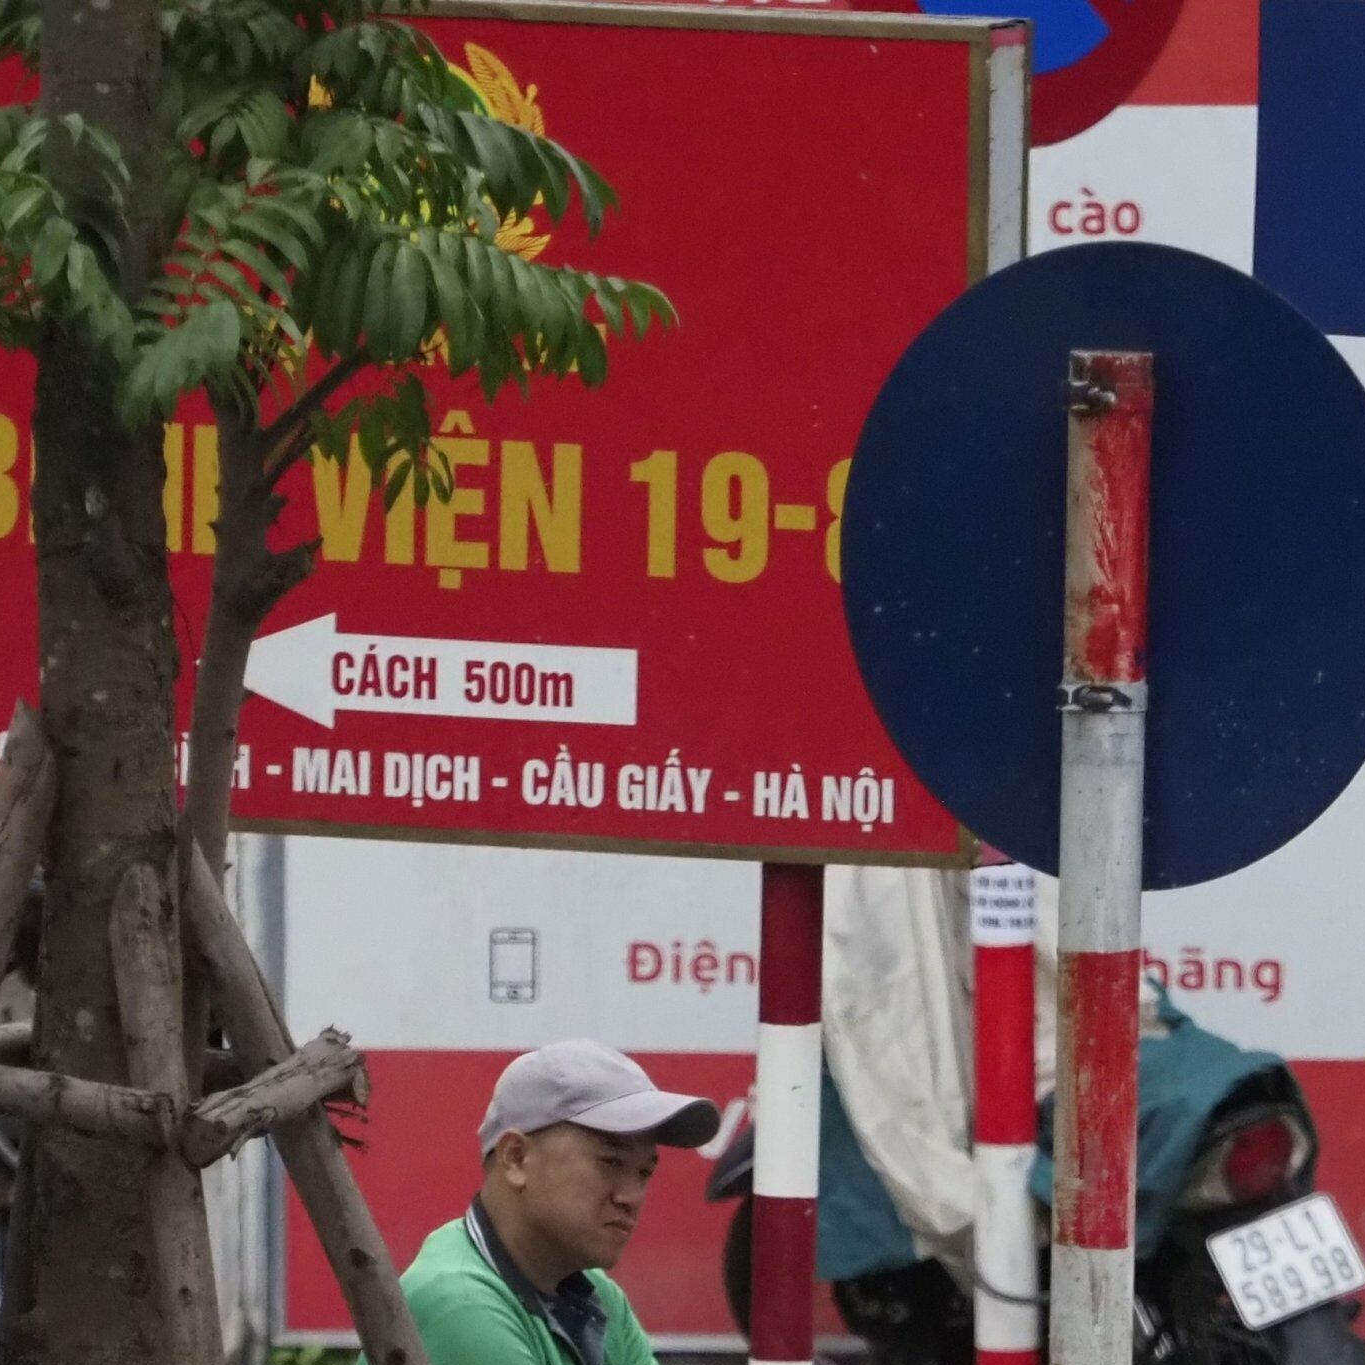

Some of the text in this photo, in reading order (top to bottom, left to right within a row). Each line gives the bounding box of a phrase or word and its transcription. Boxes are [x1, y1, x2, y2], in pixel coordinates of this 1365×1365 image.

[1048, 187, 1142, 236] cào
[311, 409, 582, 591] VIỆN
[331, 643, 574, 708] CÁCH 500m
[291, 747, 370, 796] MAI
[383, 752, 480, 807] DỊCH
[521, 743, 605, 808] CẦU
[617, 747, 713, 814] GIẤY
[753, 763, 810, 820] HÀ
[822, 766, 896, 833] NỘI
[627, 939, 1282, 1004] Điện hãng
